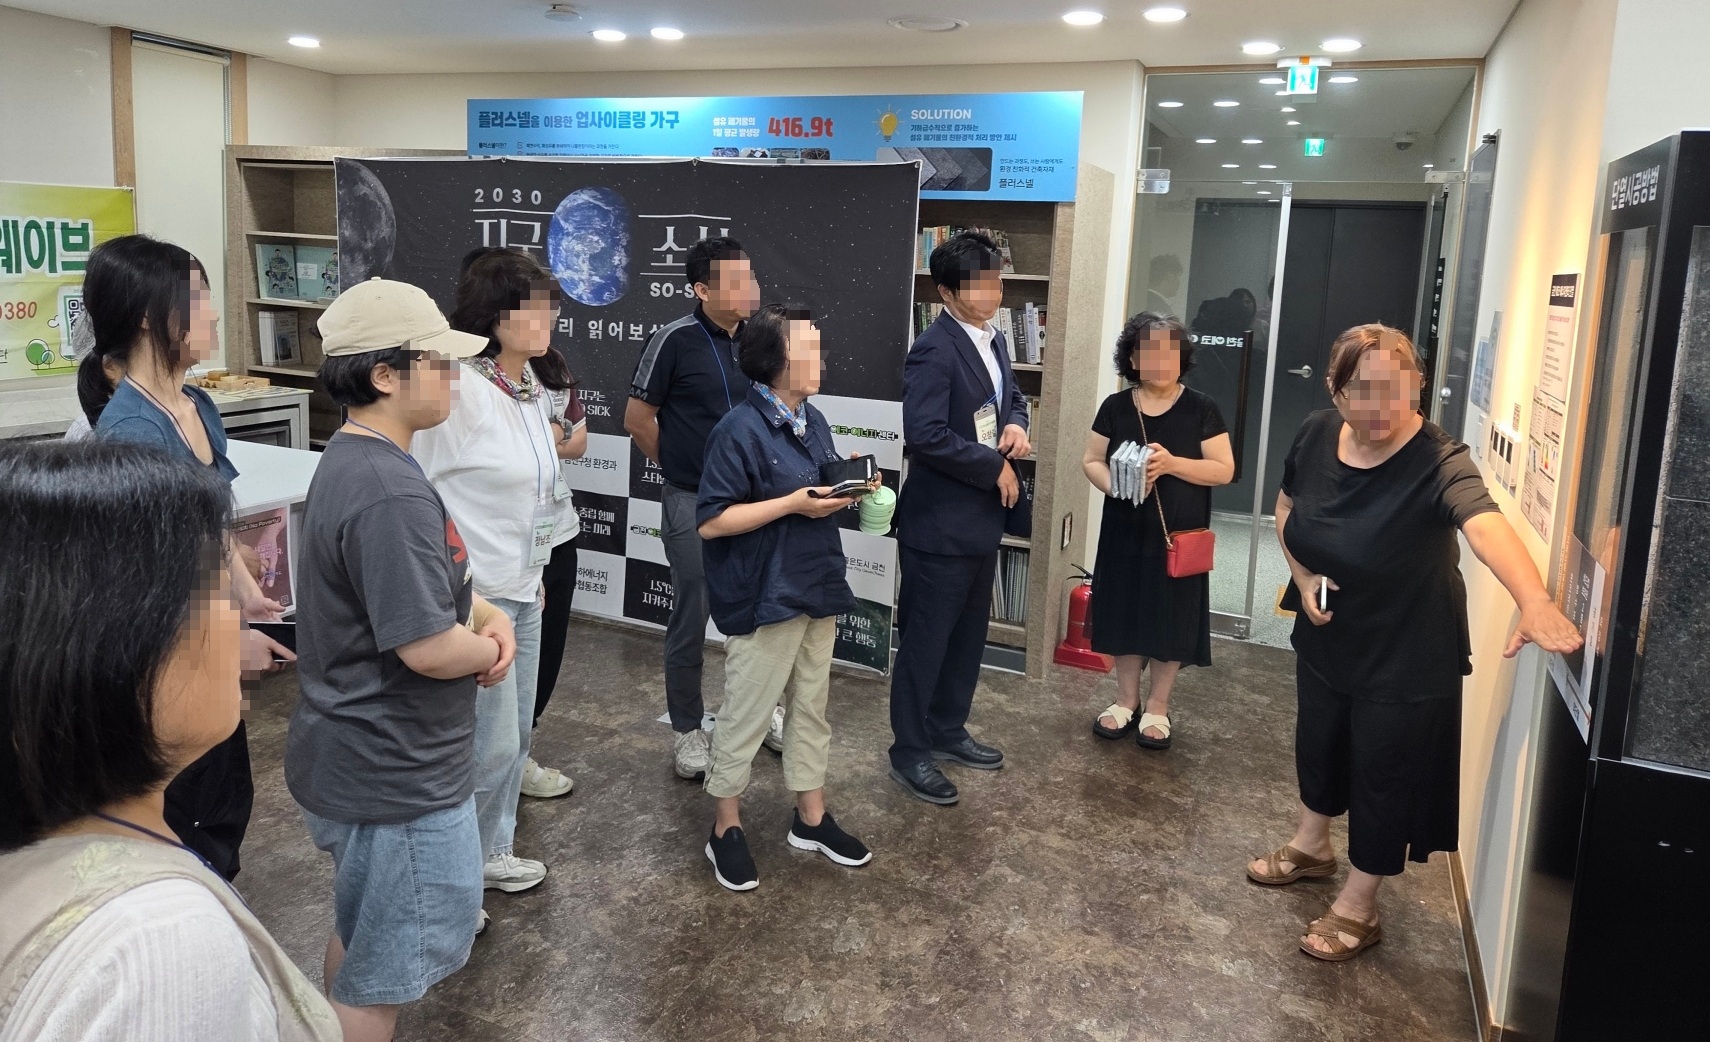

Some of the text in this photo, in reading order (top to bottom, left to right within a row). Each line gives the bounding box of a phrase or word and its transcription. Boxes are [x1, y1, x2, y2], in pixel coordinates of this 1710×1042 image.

[478, 110, 680, 129] 플러스넬을 이용한 업사이클링 가구
[910, 109, 972, 120] SOLUTION
[767, 116, 834, 138] 416.9t
[910, 124, 979, 132] 기하급수적으로 증가하는
[909, 133, 922, 142] 섬유
[949, 133, 974, 142] 친환경적
[975, 133, 988, 142] 처리
[989, 133, 1002, 142] 방안
[1003, 133, 1017, 142] 제시
[999, 178, 1034, 189] 플러스넬
[1611, 165, 1661, 211] 단열시공방법
[474, 188, 542, 205] 2030
[0, 301, 38, 320] 380
[577, 389, 606, 402] 지구는
[586, 404, 611, 417] SICK
[592, 457, 618, 471] 환경과
[592, 522, 611, 536] 미래
[575, 579, 608, 595] 협동조합
[849, 614, 871, 631] 위한
[855, 631, 877, 649] 행동
